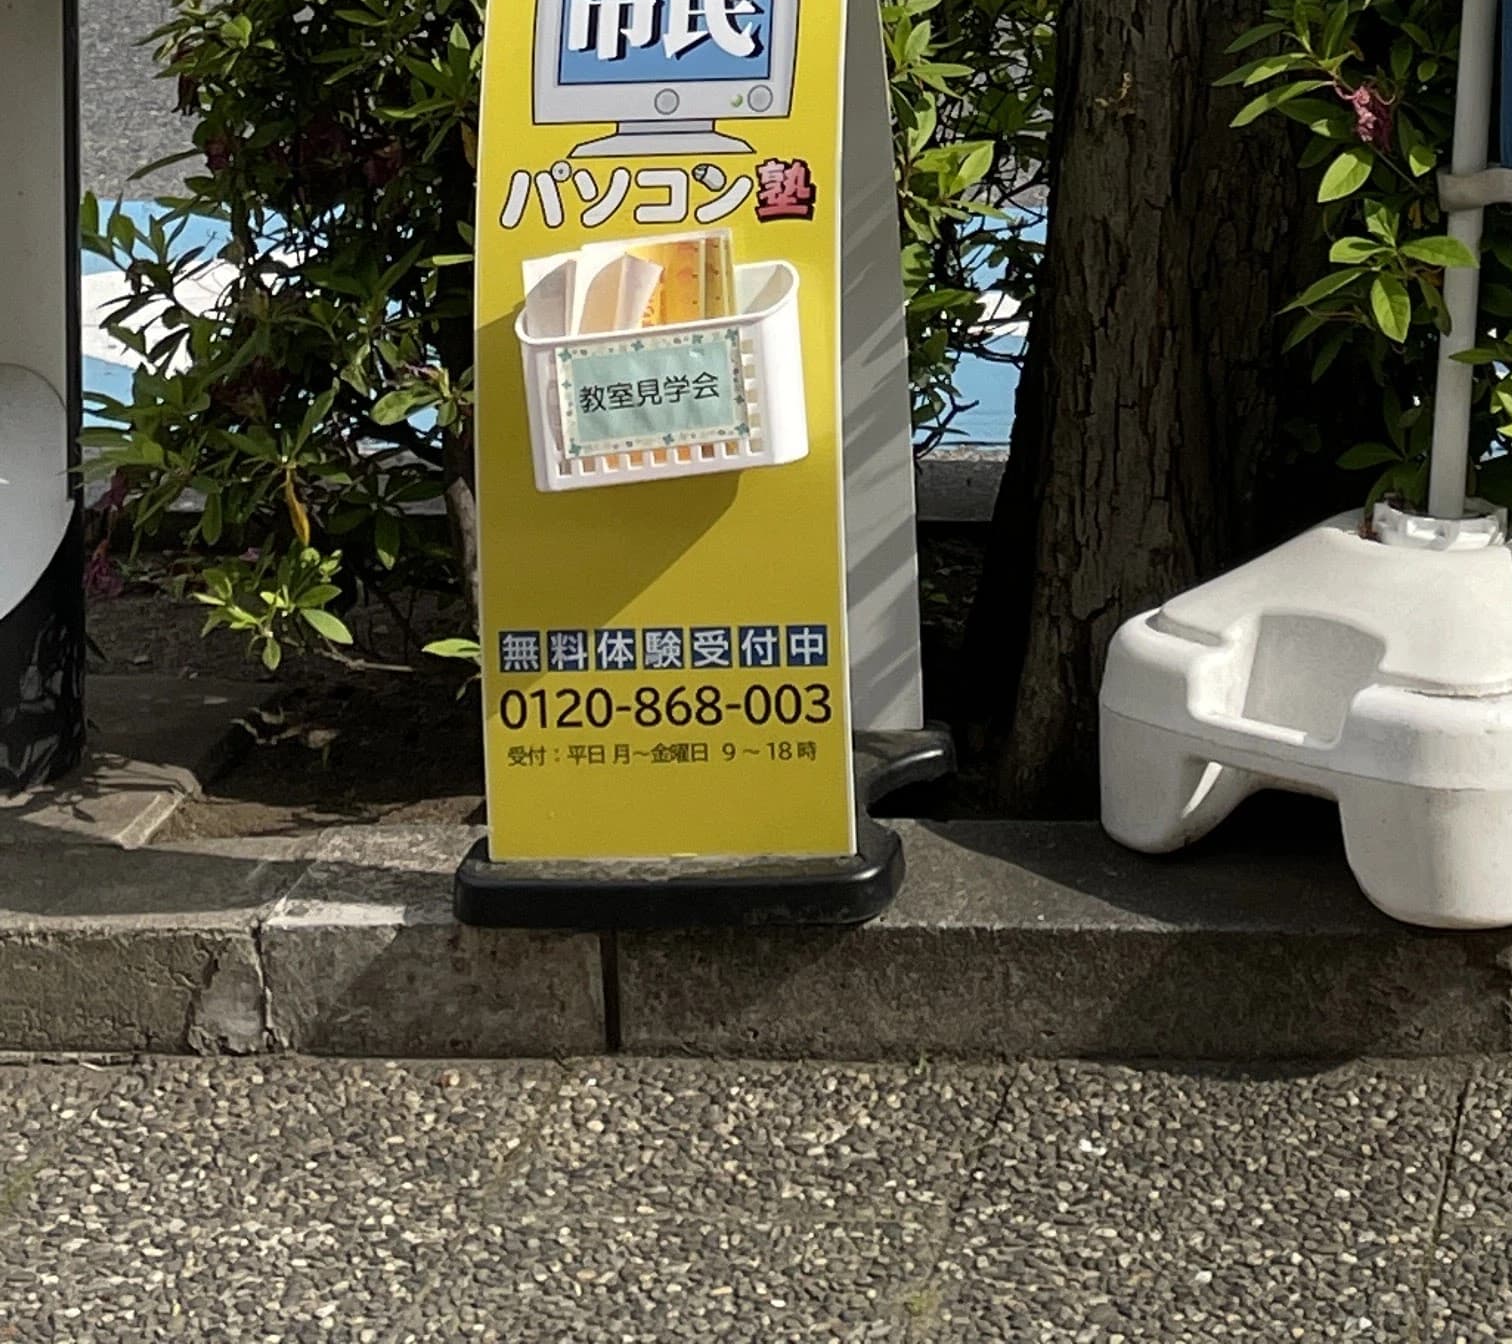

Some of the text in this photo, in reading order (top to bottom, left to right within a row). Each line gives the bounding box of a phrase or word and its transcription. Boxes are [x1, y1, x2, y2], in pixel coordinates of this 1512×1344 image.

[500, 158, 817, 230] パソコン塾
[579, 371, 721, 413] 教室見学会
[501, 627, 826, 671] 無料体験受付中
[500, 684, 832, 730] 0120-868-003
